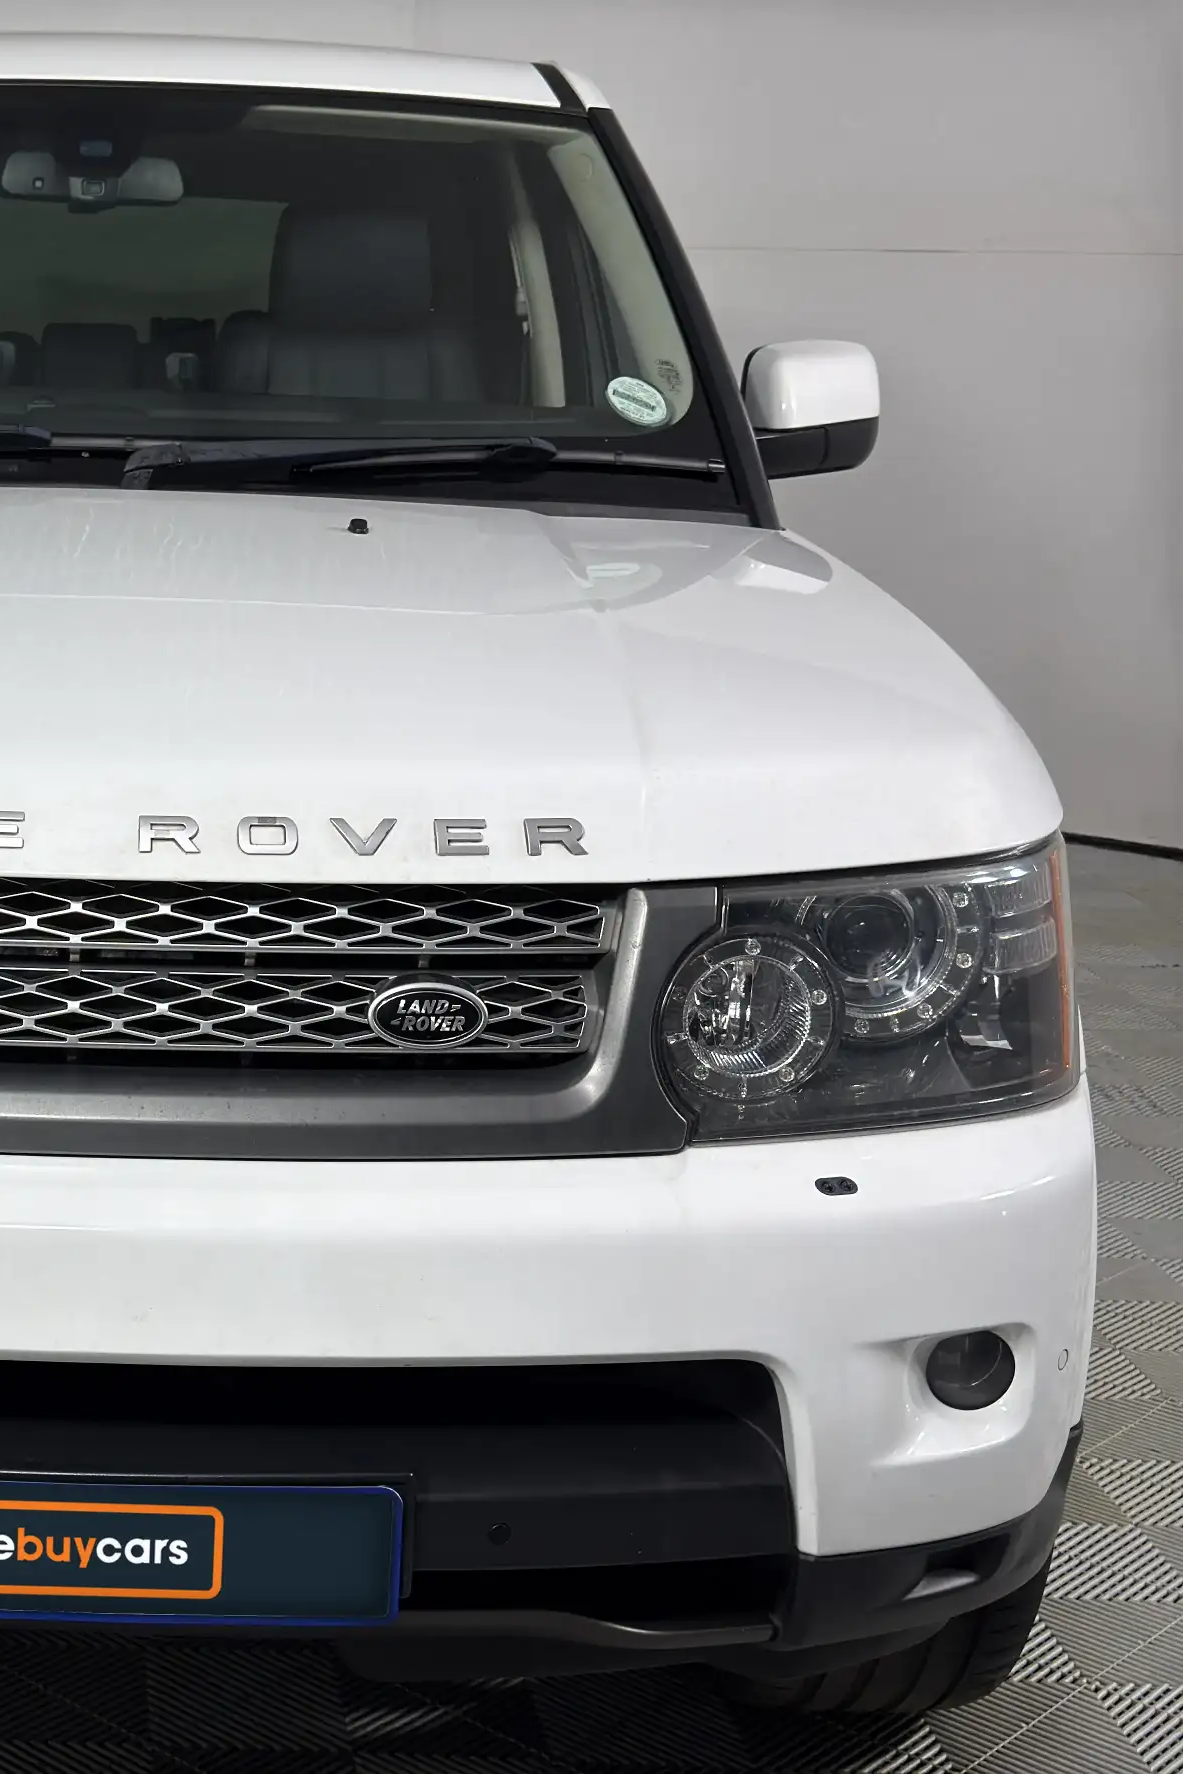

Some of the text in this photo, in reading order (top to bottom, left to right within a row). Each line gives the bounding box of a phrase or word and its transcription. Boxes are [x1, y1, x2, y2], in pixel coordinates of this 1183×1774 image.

[138, 815, 590, 857] ROVER
[397, 999, 450, 1014] LAND
[401, 1015, 466, 1032] ROVER
